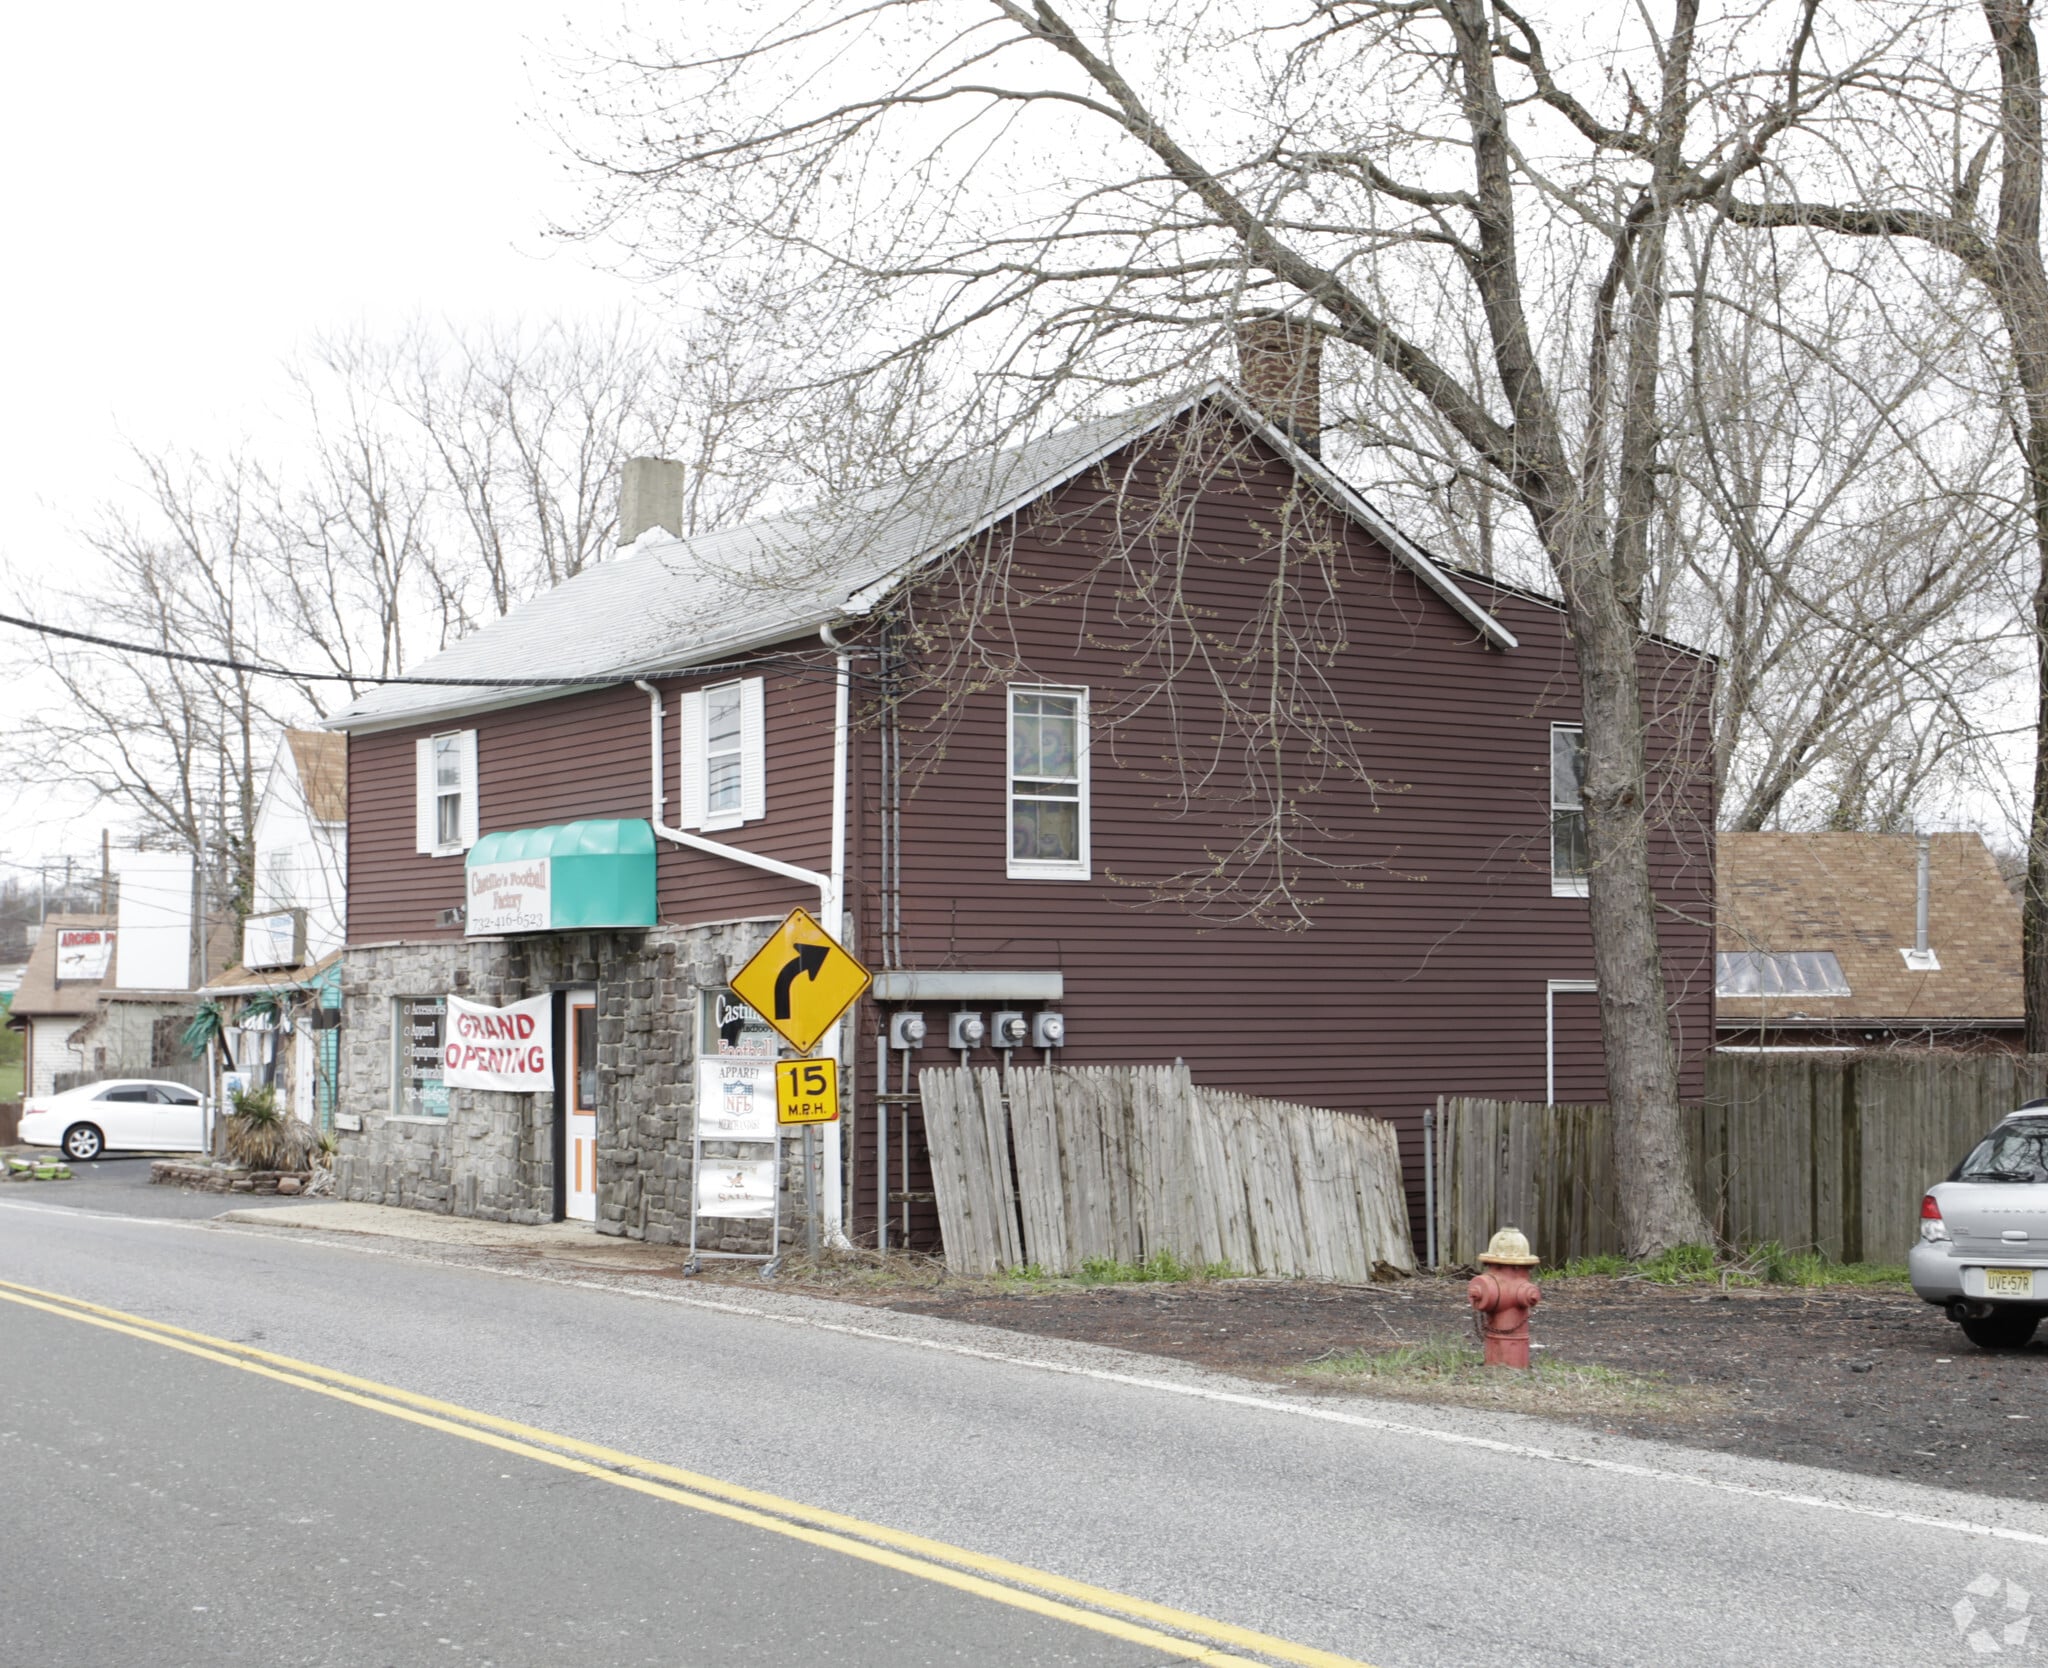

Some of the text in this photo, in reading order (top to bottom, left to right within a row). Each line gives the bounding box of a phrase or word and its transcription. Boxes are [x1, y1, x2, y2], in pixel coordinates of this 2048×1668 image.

[509, 861, 546, 891] Football
[493, 891, 523, 913] Factory
[472, 912, 544, 932] 732-416-6523
[61, 932, 101, 947] ARCHER
[457, 1013, 535, 1040] GRAND
[445, 1043, 545, 1073] OPENING
[790, 1065, 827, 1097] 15
[788, 1103, 827, 1116] M.P.H.
